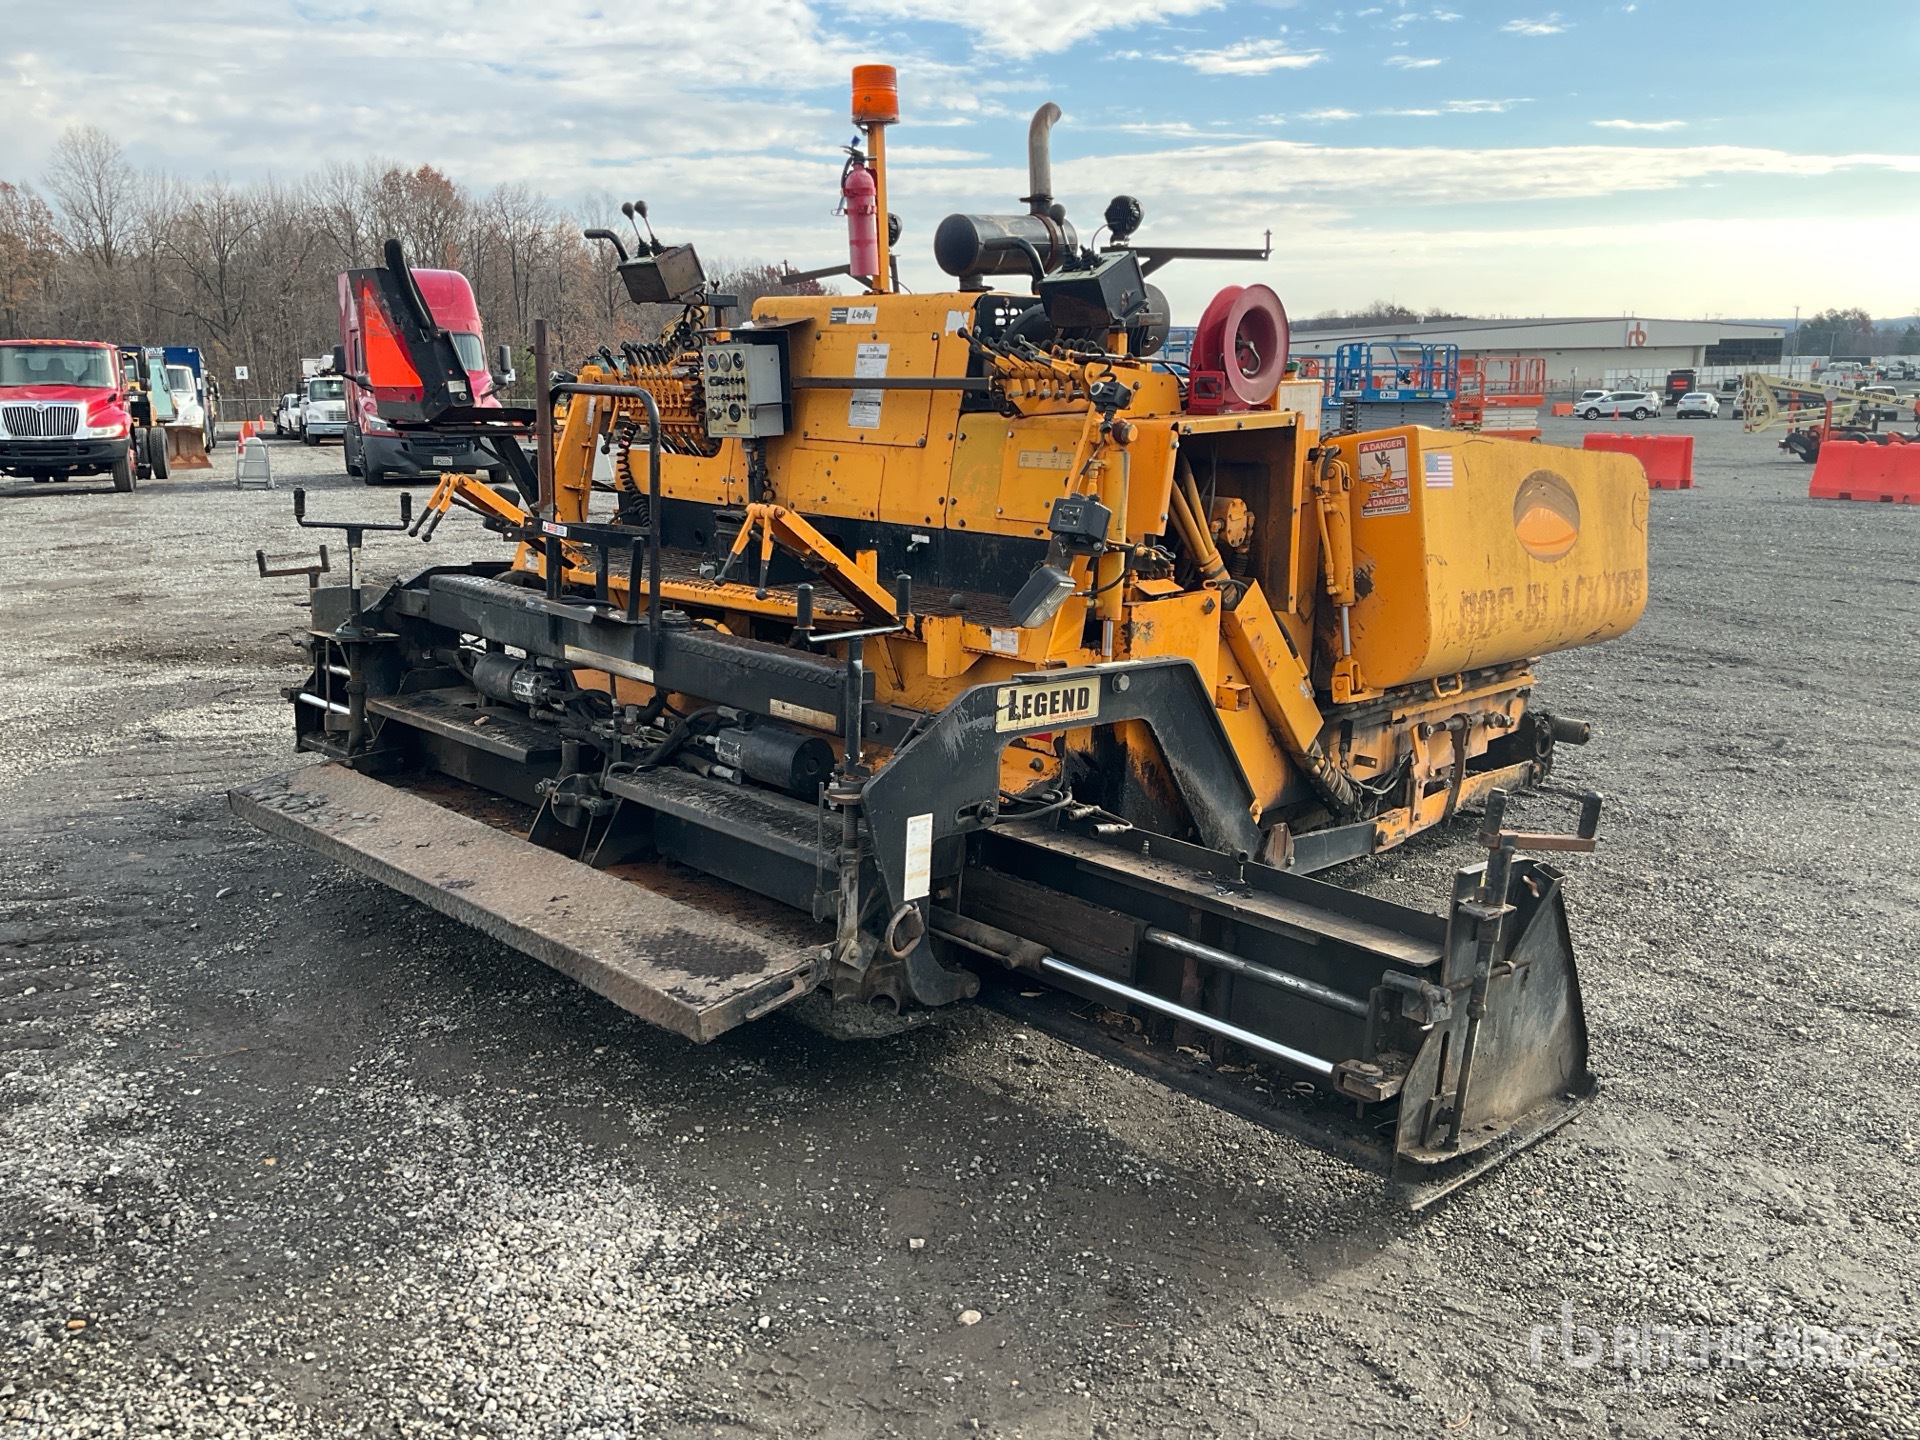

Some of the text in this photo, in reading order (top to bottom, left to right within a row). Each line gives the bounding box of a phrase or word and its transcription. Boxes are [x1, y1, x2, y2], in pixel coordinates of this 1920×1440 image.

[1628, 321, 1647, 348] rb
[1370, 439, 1402, 452] DANGER
[1373, 496, 1406, 507] DANGER
[1008, 687, 1090, 721] LEGEND
